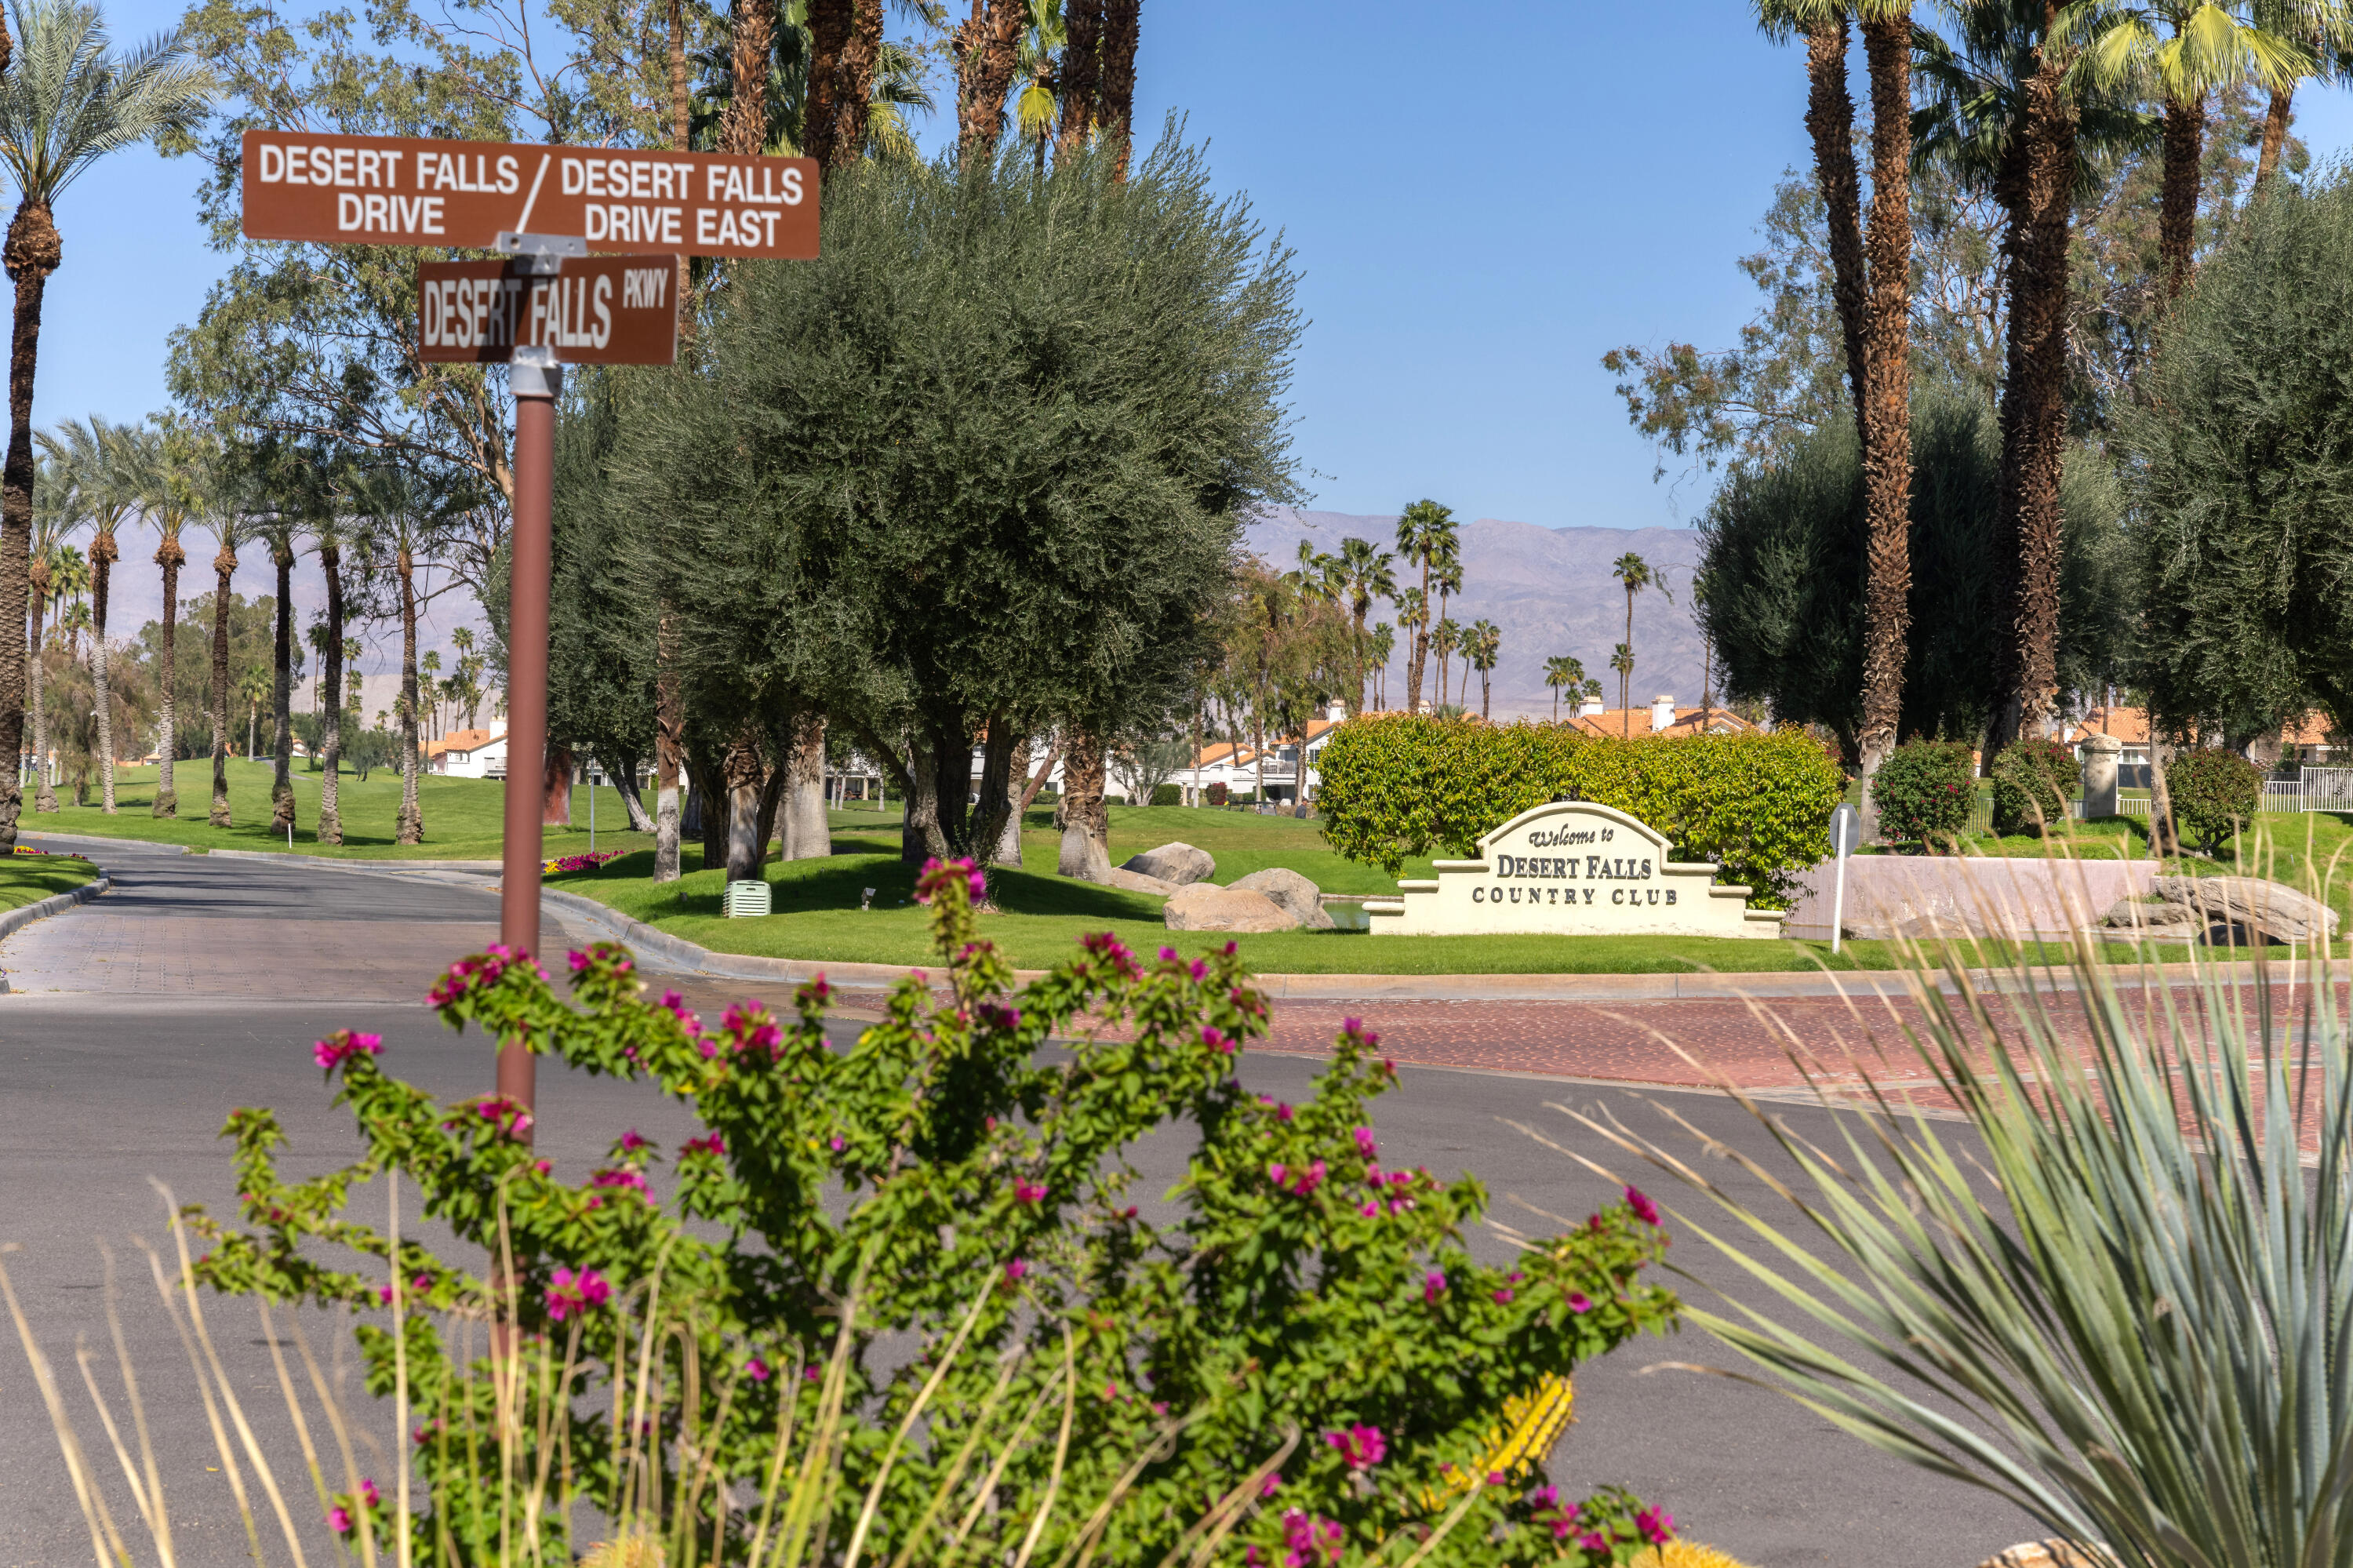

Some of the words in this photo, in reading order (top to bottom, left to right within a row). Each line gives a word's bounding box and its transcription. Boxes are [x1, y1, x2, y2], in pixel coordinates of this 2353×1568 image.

[260, 144, 402, 188] DESERT
[416, 153, 519, 194] FALLS
[562, 158, 694, 200] DESERT
[707, 166, 804, 206] FALLS
[338, 193, 445, 235] DRIVE
[585, 203, 682, 245] DRIVE
[696, 209, 781, 248] EAST
[424, 278, 522, 347] DESERT
[530, 274, 613, 349] FALLS
[623, 268, 668, 308] PKWY
[1529, 824, 1595, 847] Welcome
[1601, 826, 1614, 843] to
[1497, 854, 1580, 879] DESERT
[1586, 854, 1652, 880] FALLS
[1471, 886, 1595, 904] COUNTRY
[1611, 888, 1678, 906] CLUB
